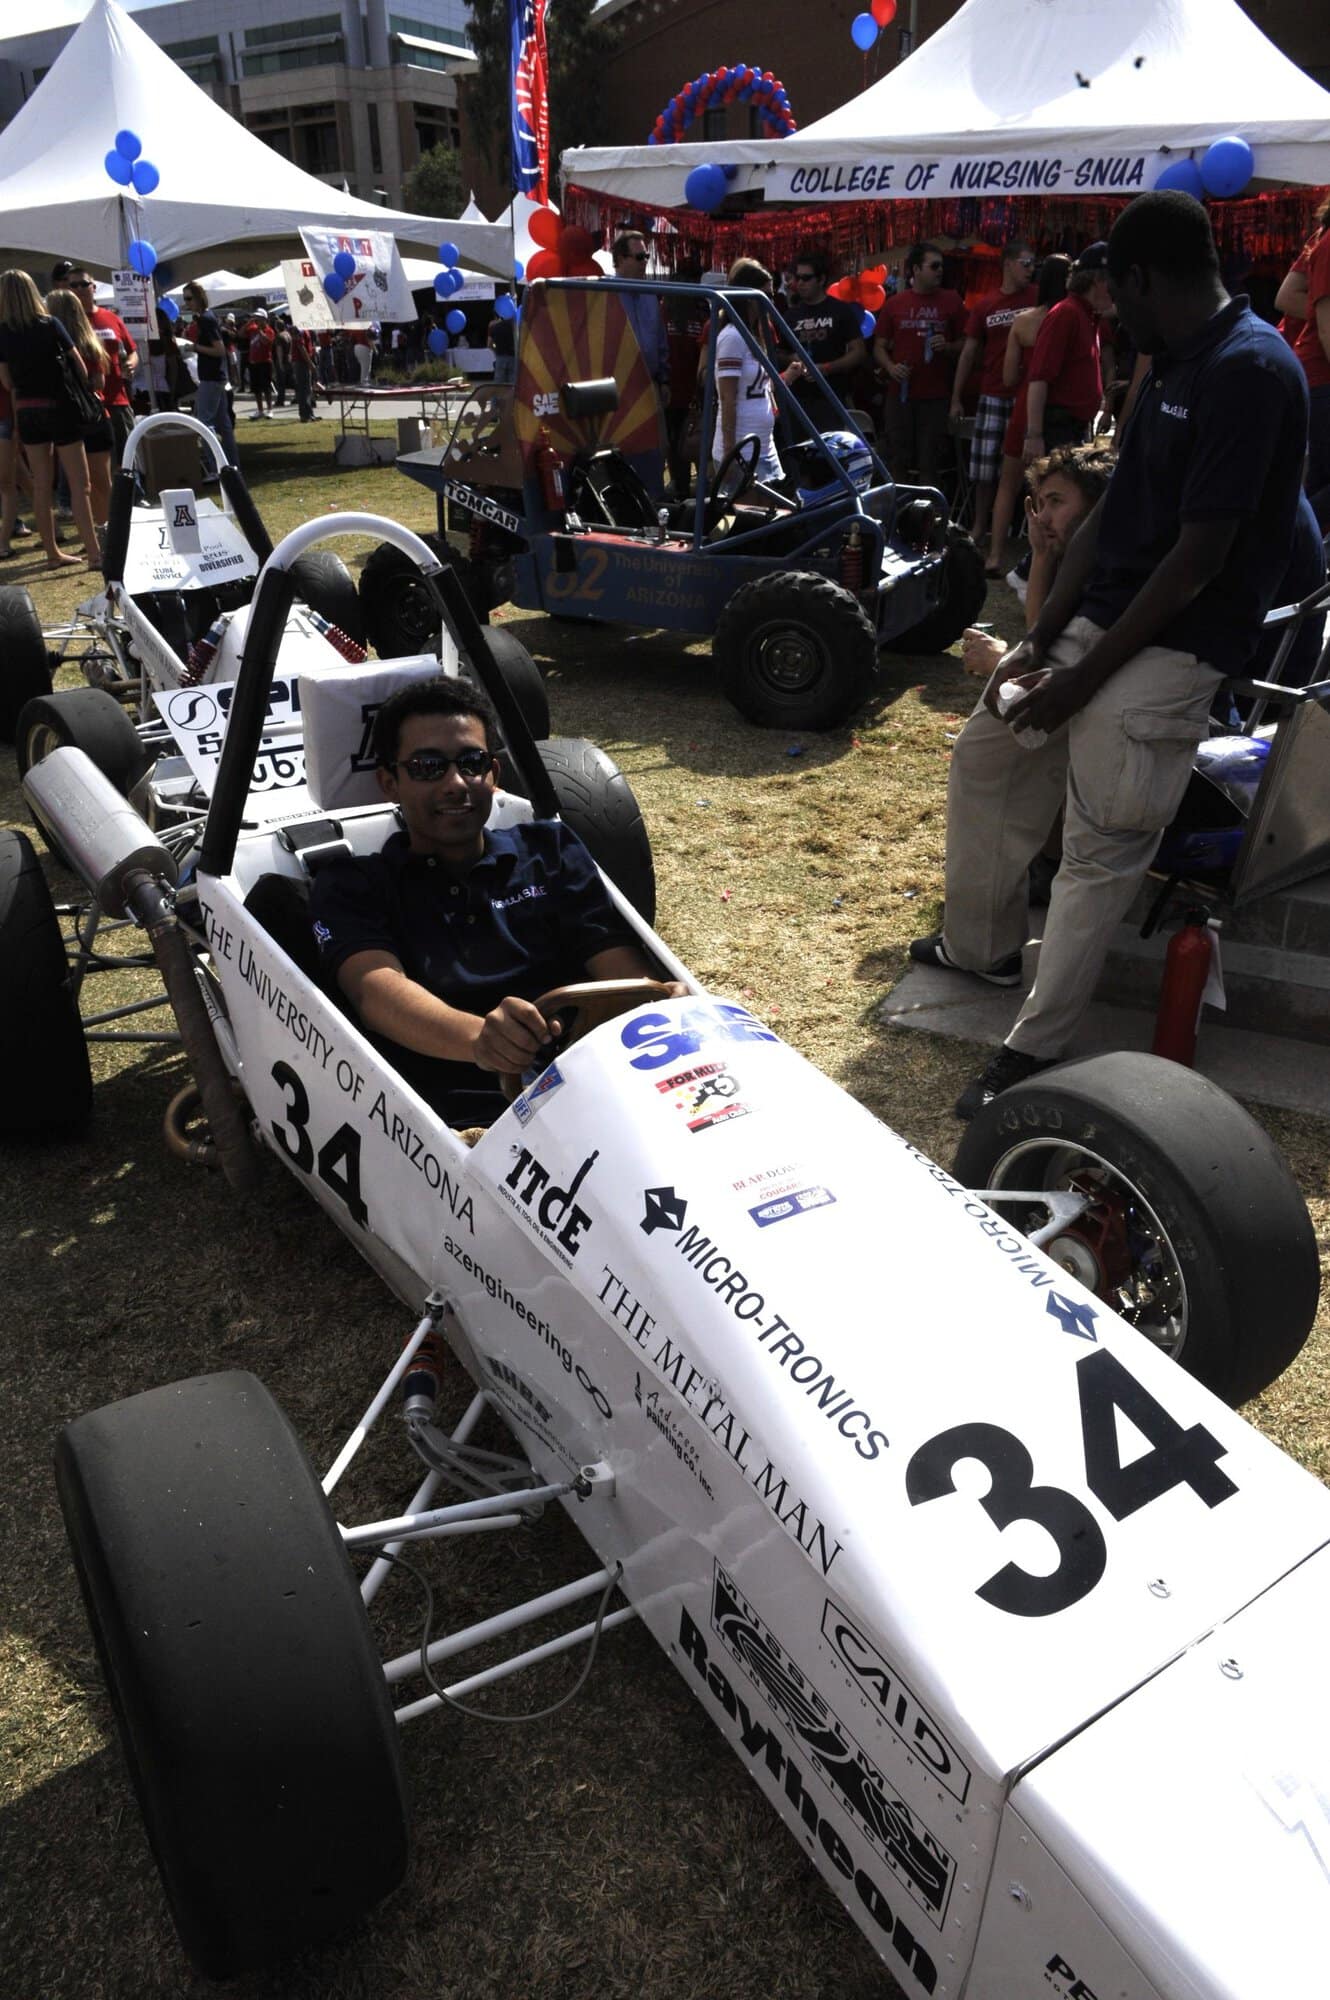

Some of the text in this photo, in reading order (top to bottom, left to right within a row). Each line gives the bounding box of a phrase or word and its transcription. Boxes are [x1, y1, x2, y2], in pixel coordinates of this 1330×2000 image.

[326, 235, 373, 256] SALT
[790, 163, 895, 194] COLLEGE
[906, 163, 939, 192] OF
[533, 392, 560, 417] SAE
[446, 482, 519, 532] TOMCAR
[200, 903, 476, 1236] THE UNIVERSITY OF ARIZONA
[270, 1060, 370, 1228] 34
[514, 1098, 530, 1117] OFF
[443, 1234, 573, 1373] azengineering
[674, 1225, 890, 1460] MICRO-TRONICS
[595, 1264, 845, 1577] THE METAL MAN
[646, 1405, 683, 1461] painting
[647, 1391, 700, 1463] Anderson
[905, 1346, 1241, 1618] 34
[715, 1622, 796, 1737] HONDA
[718, 1567, 950, 1868] MUSSELMAN
[818, 1644, 963, 1823] INDUSTRIES
[835, 1624, 952, 1775] CAID
[678, 1604, 938, 1997] Raytheon
[811, 1755, 935, 1913] CIRCUIT
